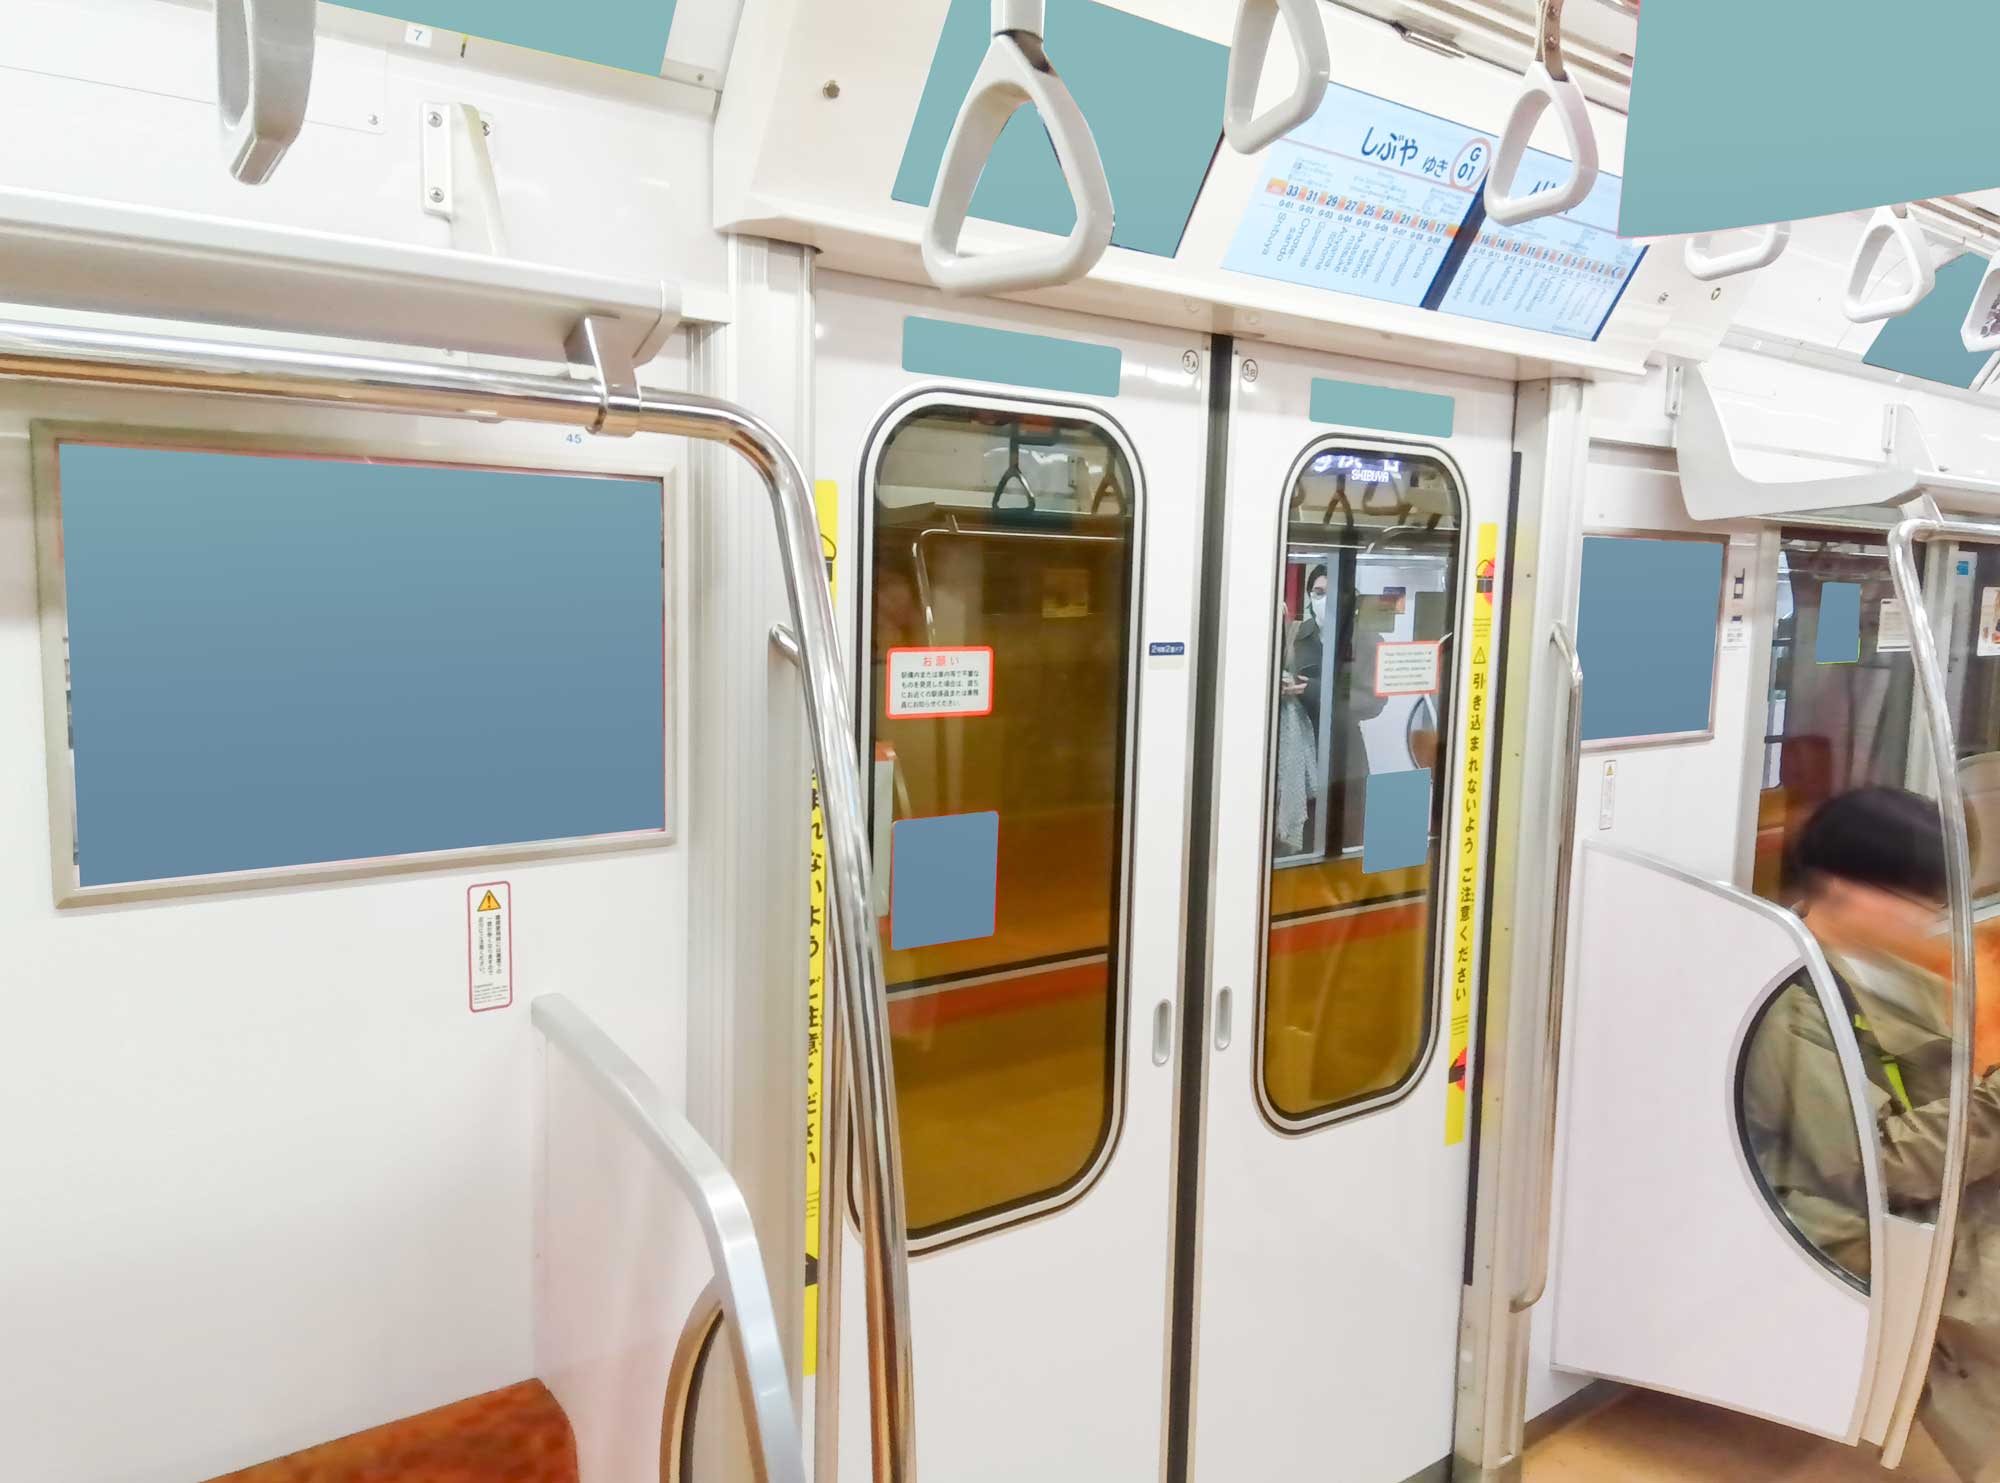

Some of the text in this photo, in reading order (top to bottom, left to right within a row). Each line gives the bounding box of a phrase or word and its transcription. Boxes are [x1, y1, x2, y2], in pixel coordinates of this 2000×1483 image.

[413, 29, 423, 41] 7
[1361, 127, 1448, 178] しぶや ゆき
[1470, 147, 1482, 162] G
[1457, 163, 1476, 180] 01
[1286, 185, 1447, 234] 33 31 29 27 25 23 21 19 17
[1262, 212, 1287, 256] Shibuya
[566, 433, 582, 445] 45
[1351, 468, 1389, 483] SHIBUYA
[1464, 672, 1486, 855] 引き込まれないよう
